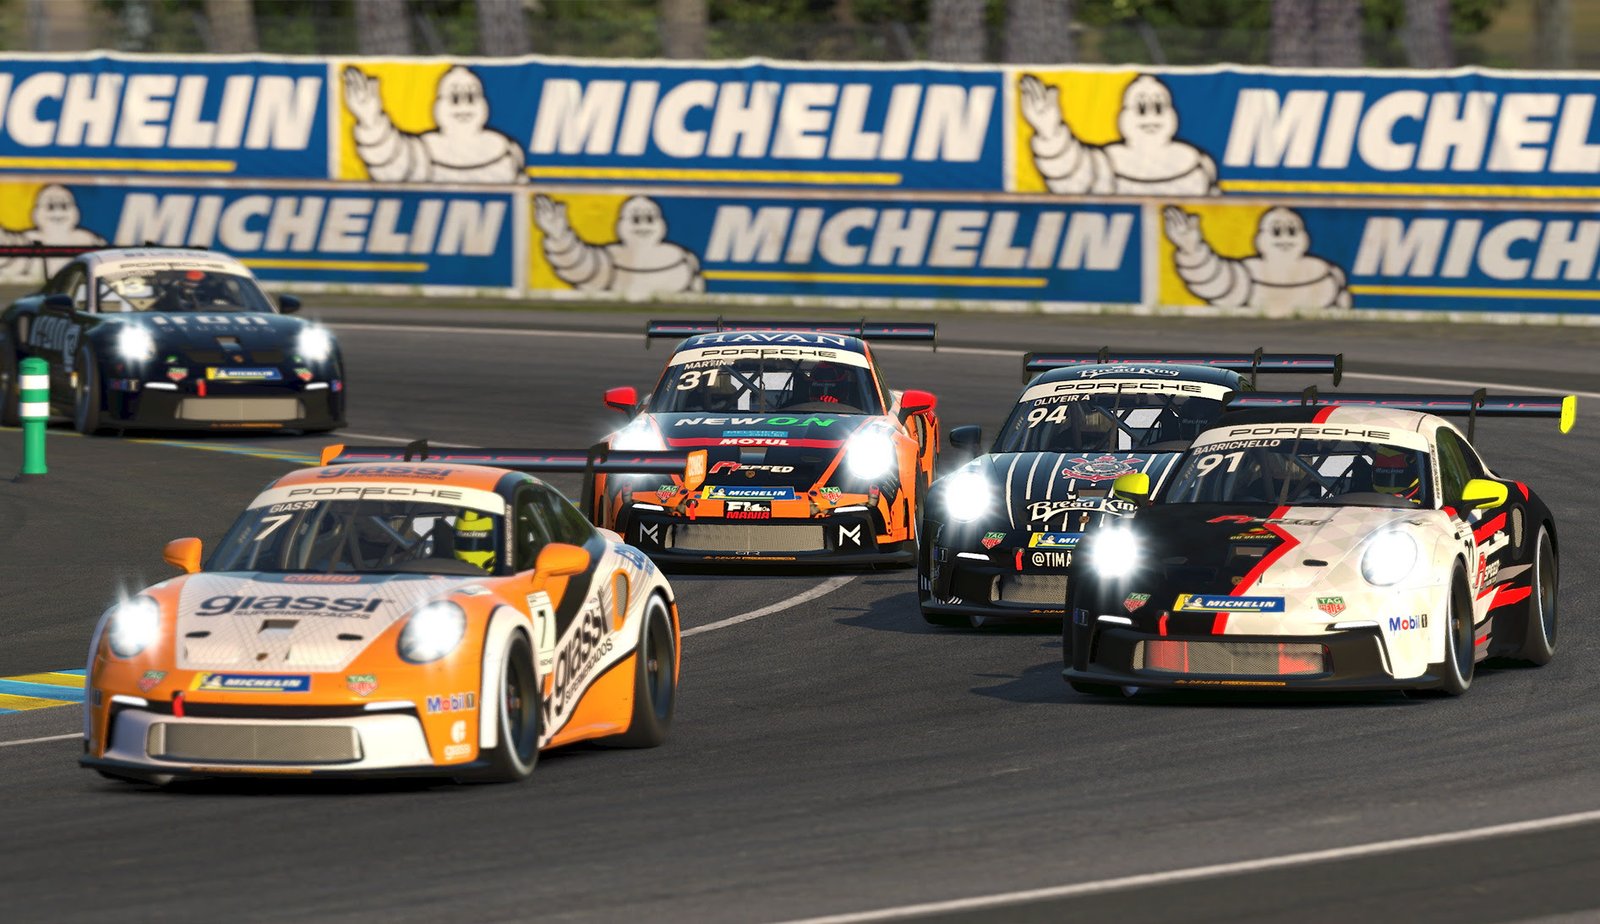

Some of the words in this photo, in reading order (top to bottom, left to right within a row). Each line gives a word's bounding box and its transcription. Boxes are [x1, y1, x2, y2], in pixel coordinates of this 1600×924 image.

[0, 72, 323, 150] CHELIN
[529, 78, 996, 162] MICHELIN
[1223, 88, 1600, 173] MICHEL
[113, 193, 508, 256] MICHELIN
[705, 205, 1134, 270] MICHELIN
[1352, 216, 1600, 280] MICH
[693, 333, 846, 347] HAVAN
[701, 348, 838, 359] PORSCHE
[676, 368, 720, 391] 31
[1054, 382, 1202, 393] PORSCHE
[1026, 404, 1070, 430] 94
[1229, 427, 1391, 440] PORSCHE
[718, 438, 790, 446] MOTUL
[1193, 439, 1281, 456] BARRICHELLO
[1195, 451, 1246, 478] 91
[288, 486, 463, 500] PORSCHE
[660, 485, 679, 493] TAG
[728, 489, 787, 497] MICHELIN
[819, 486, 840, 494] TAG
[269, 500, 319, 514] GIASSI
[1026, 500, 1095, 522] Bread
[1099, 499, 1138, 512] Kin
[726, 511, 771, 520] MANIA
[253, 513, 293, 541] 7
[194, 594, 384, 616] giassi
[1206, 599, 1276, 608] MICHELIN
[1319, 597, 1343, 605] TAG
[233, 609, 372, 620] SUPERMERCADOS
[537, 609, 547, 649] 7
[1389, 615, 1420, 631] Mobil
[223, 677, 303, 688] MICHELIN
[426, 692, 465, 713] Mobil
